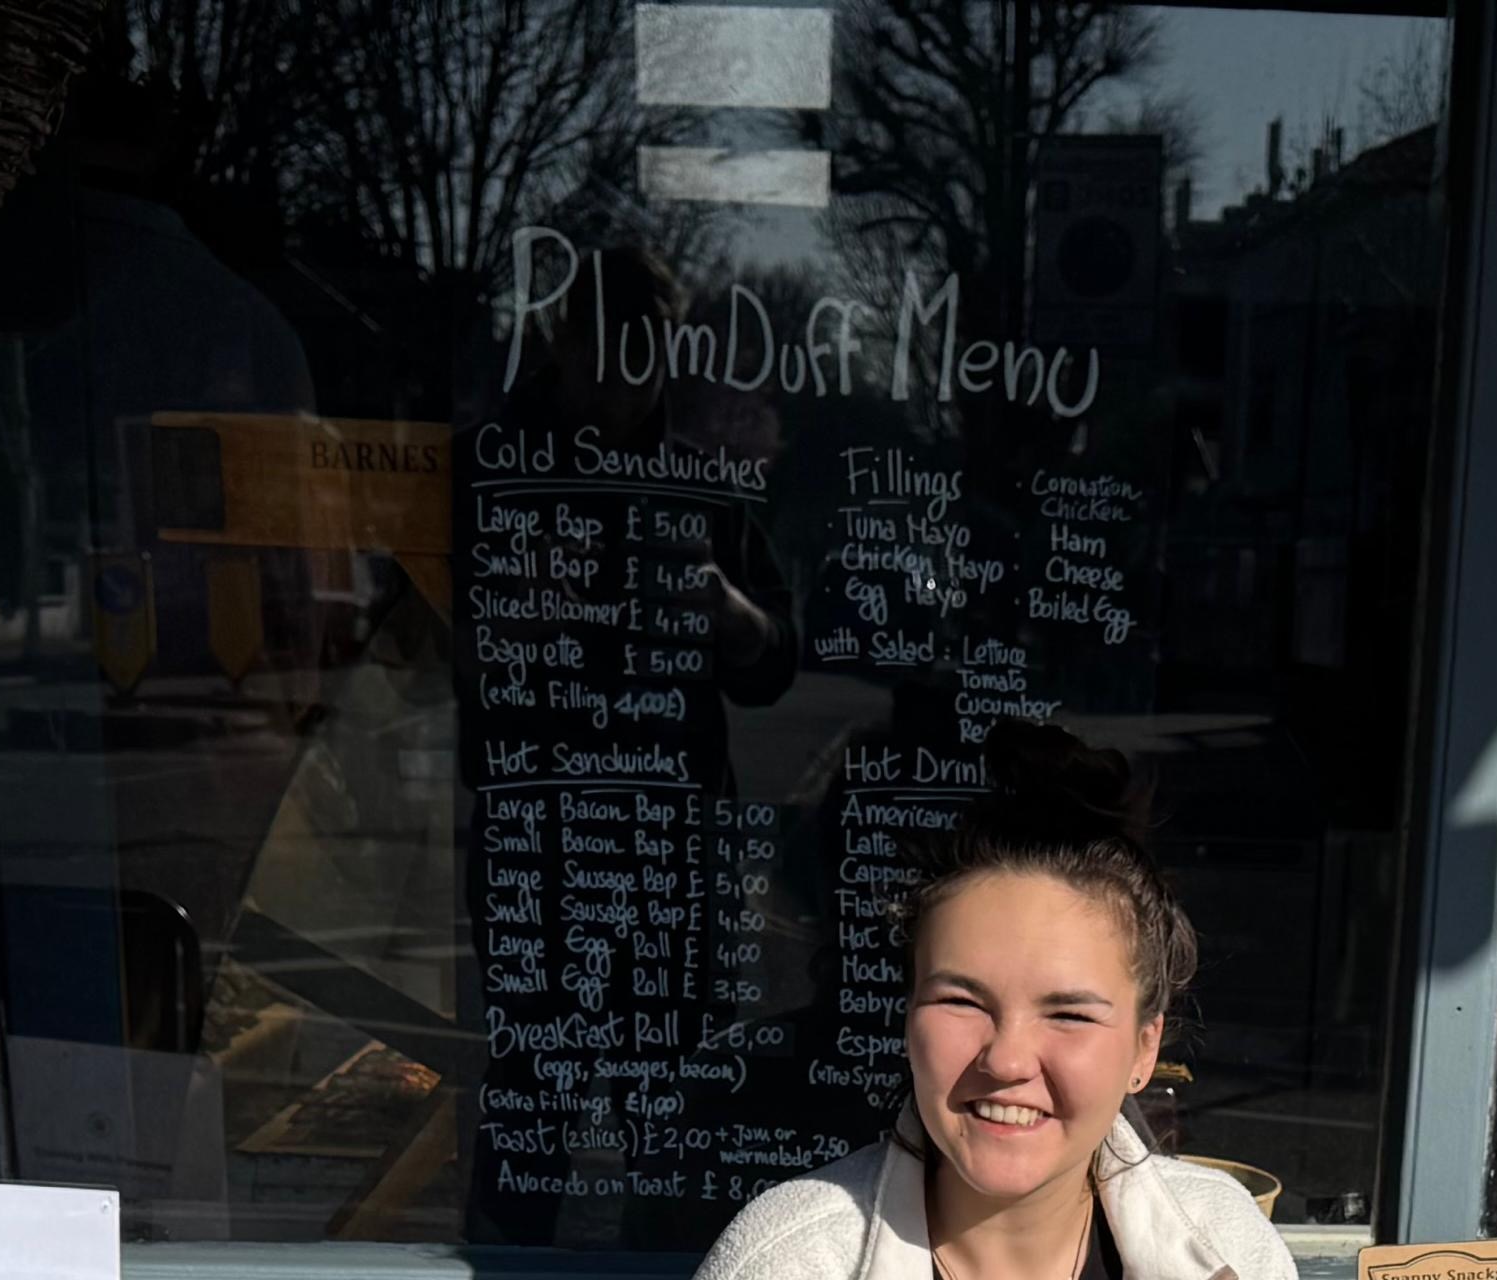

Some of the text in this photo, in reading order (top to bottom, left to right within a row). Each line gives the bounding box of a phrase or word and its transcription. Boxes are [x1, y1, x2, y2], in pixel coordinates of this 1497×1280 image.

[892, 269, 1100, 418] Menu
[312, 441, 439, 473] BARNES
[475, 422, 555, 474] Cold
[839, 446, 963, 523] Fillings
[1031, 469, 1143, 500] Coronation
[477, 494, 604, 553] Large Bap
[1040, 497, 1131, 522] Chicken
[838, 508, 971, 557] Tuna Mayo
[1051, 523, 1106, 559] Ham
[471, 543, 600, 588] Small Bap
[841, 542, 1004, 594] Chicken Mayo
[1046, 556, 1124, 592] Cheese
[470, 584, 627, 628] Sliced Bloomer
[845, 576, 888, 625] Egg
[1028, 587, 1137, 645] Boiled Egg
[815, 626, 860, 657] with
[962, 635, 1027, 669] Lettuce
[956, 667, 1026, 692] Tomato
[955, 691, 1061, 719] Cucumber
[485, 740, 689, 783] Hot Sandwiches
[844, 746, 902, 782] Hot
[845, 829, 897, 856] Latte
[486, 1005, 680, 1058] Breakfast Roll
[534, 1053, 747, 1094] (eggs, sausages, bacon)
[480, 1118, 557, 1155] Toast
[497, 1160, 687, 1198] Avocado on Toast
